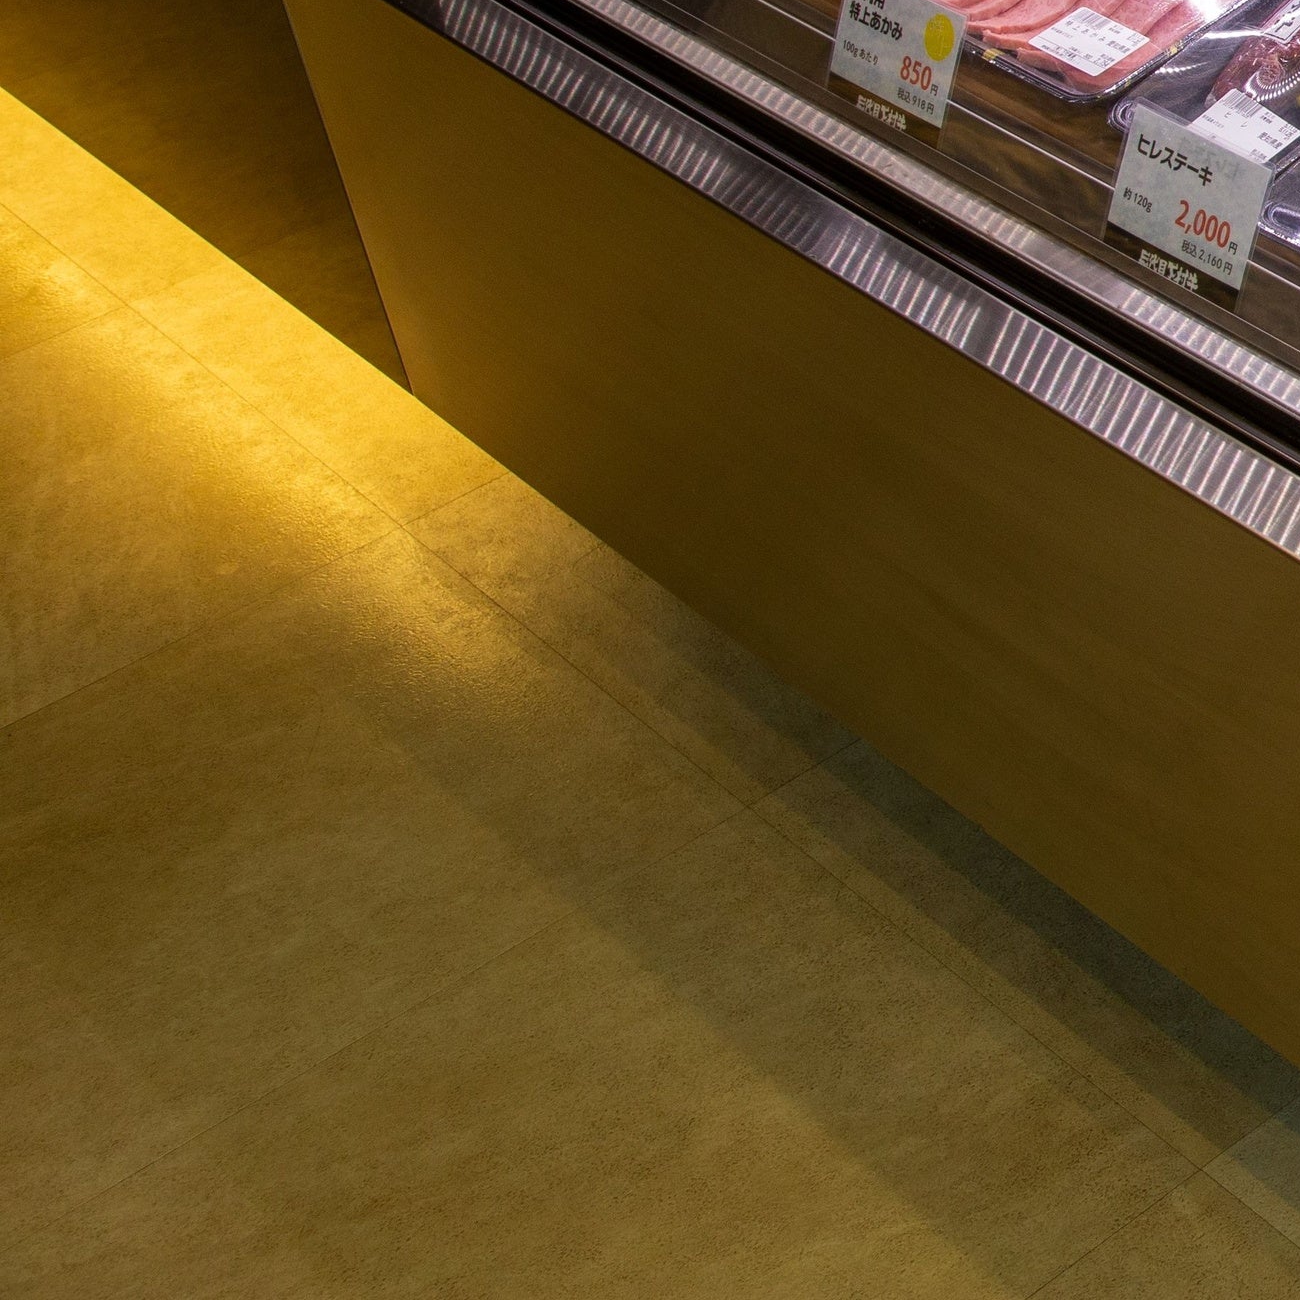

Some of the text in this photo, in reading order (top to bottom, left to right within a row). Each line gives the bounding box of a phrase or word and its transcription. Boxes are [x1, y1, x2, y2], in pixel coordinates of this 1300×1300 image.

[849, 0, 903, 41] 特上あかみ
[843, 39, 879, 65] 100g あたり
[900, 55, 939, 97] 850 円
[912, 97, 926, 110] 918
[926, 102, 935, 115] 円
[1137, 133, 1214, 187] ヒレステーキ
[1123, 187, 1153, 214] 約 120g
[1174, 200, 1238, 256] 2,000 円
[1181, 239, 1233, 276] 税込 2,160 円
